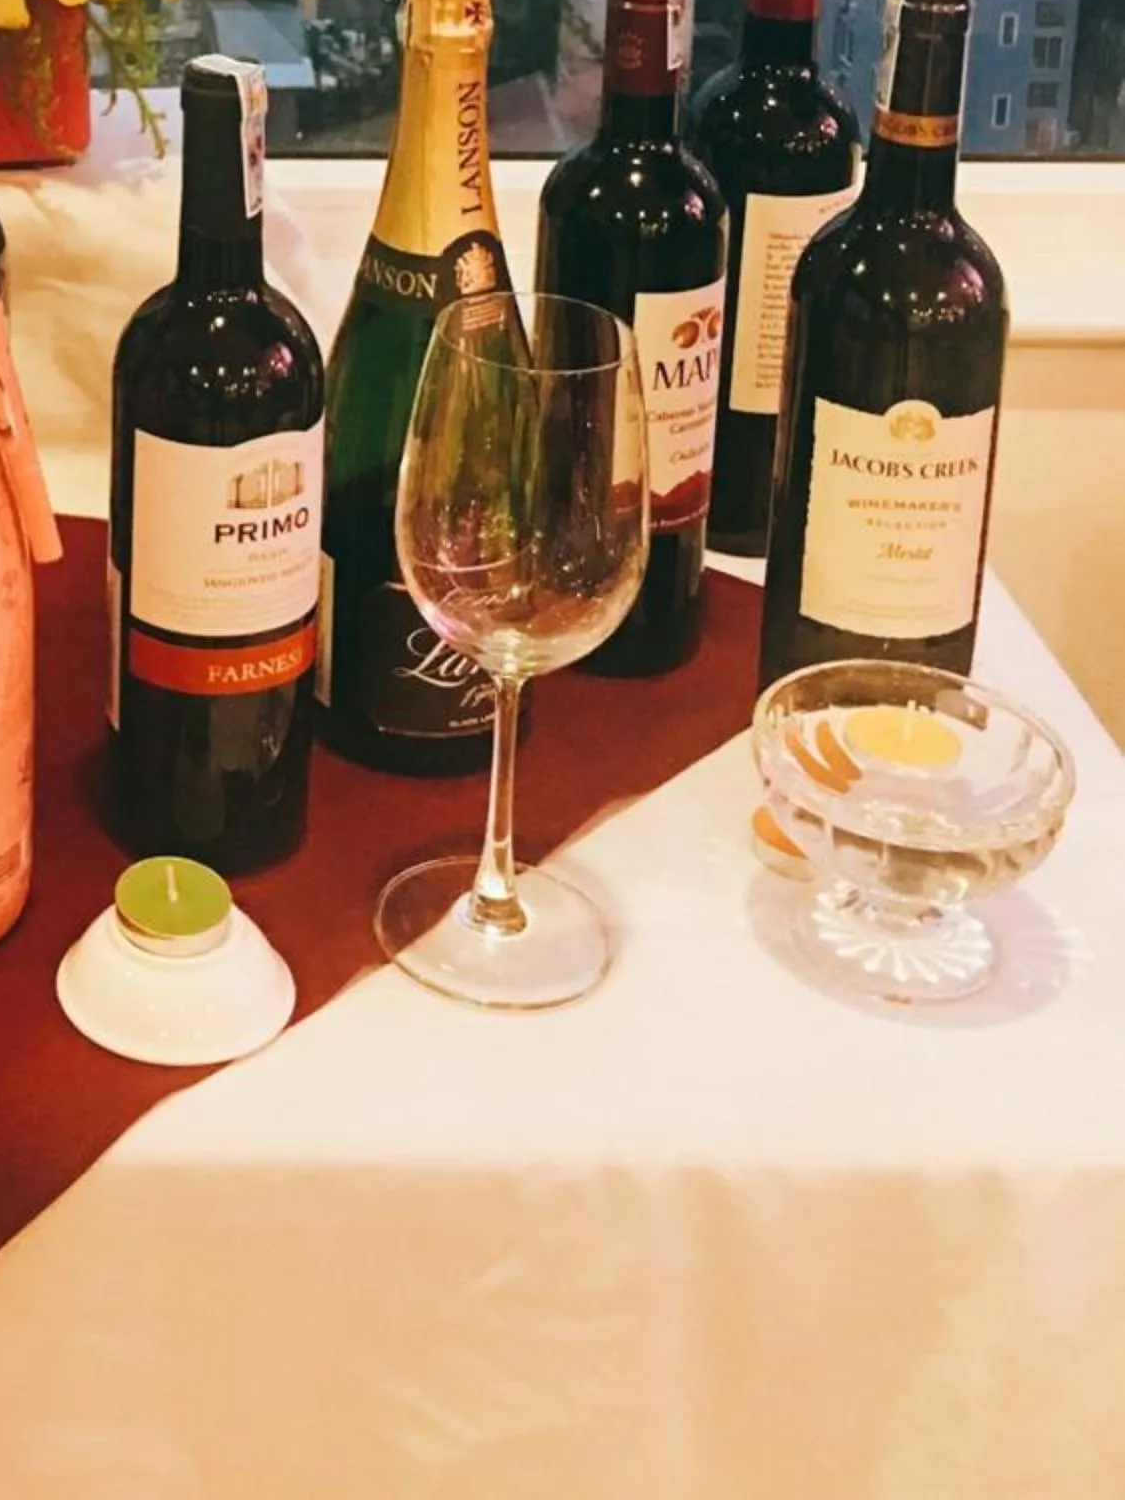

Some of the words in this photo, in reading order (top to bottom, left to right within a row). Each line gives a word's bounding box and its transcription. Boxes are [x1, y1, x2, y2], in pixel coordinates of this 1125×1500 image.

[457, 81, 482, 215] LANSON
[920, 457, 979, 480] CREEK
[214, 506, 311, 545] PRIMO
